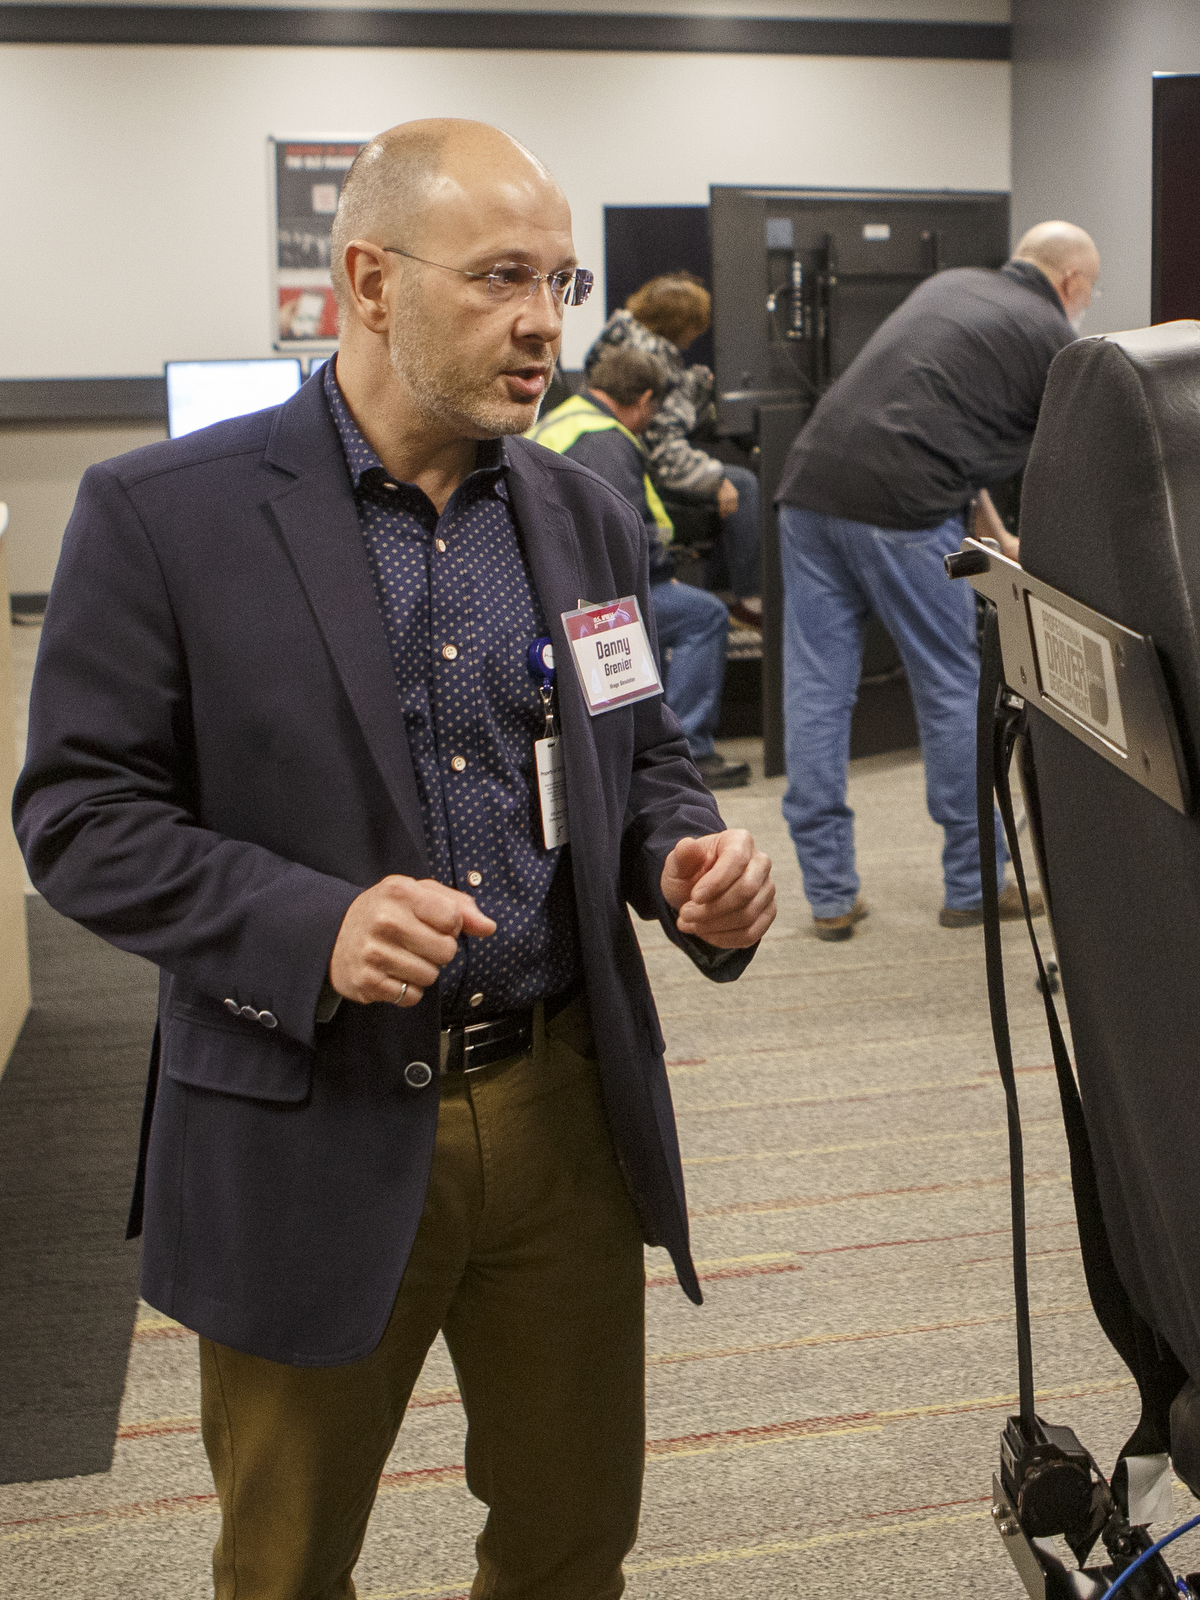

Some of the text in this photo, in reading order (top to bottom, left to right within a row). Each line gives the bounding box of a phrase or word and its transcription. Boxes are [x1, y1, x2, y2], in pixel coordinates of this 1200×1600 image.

[595, 637, 631, 660] Danny
[604, 658, 632, 676] Grenier
[1044, 630, 1089, 696] DRIVER
